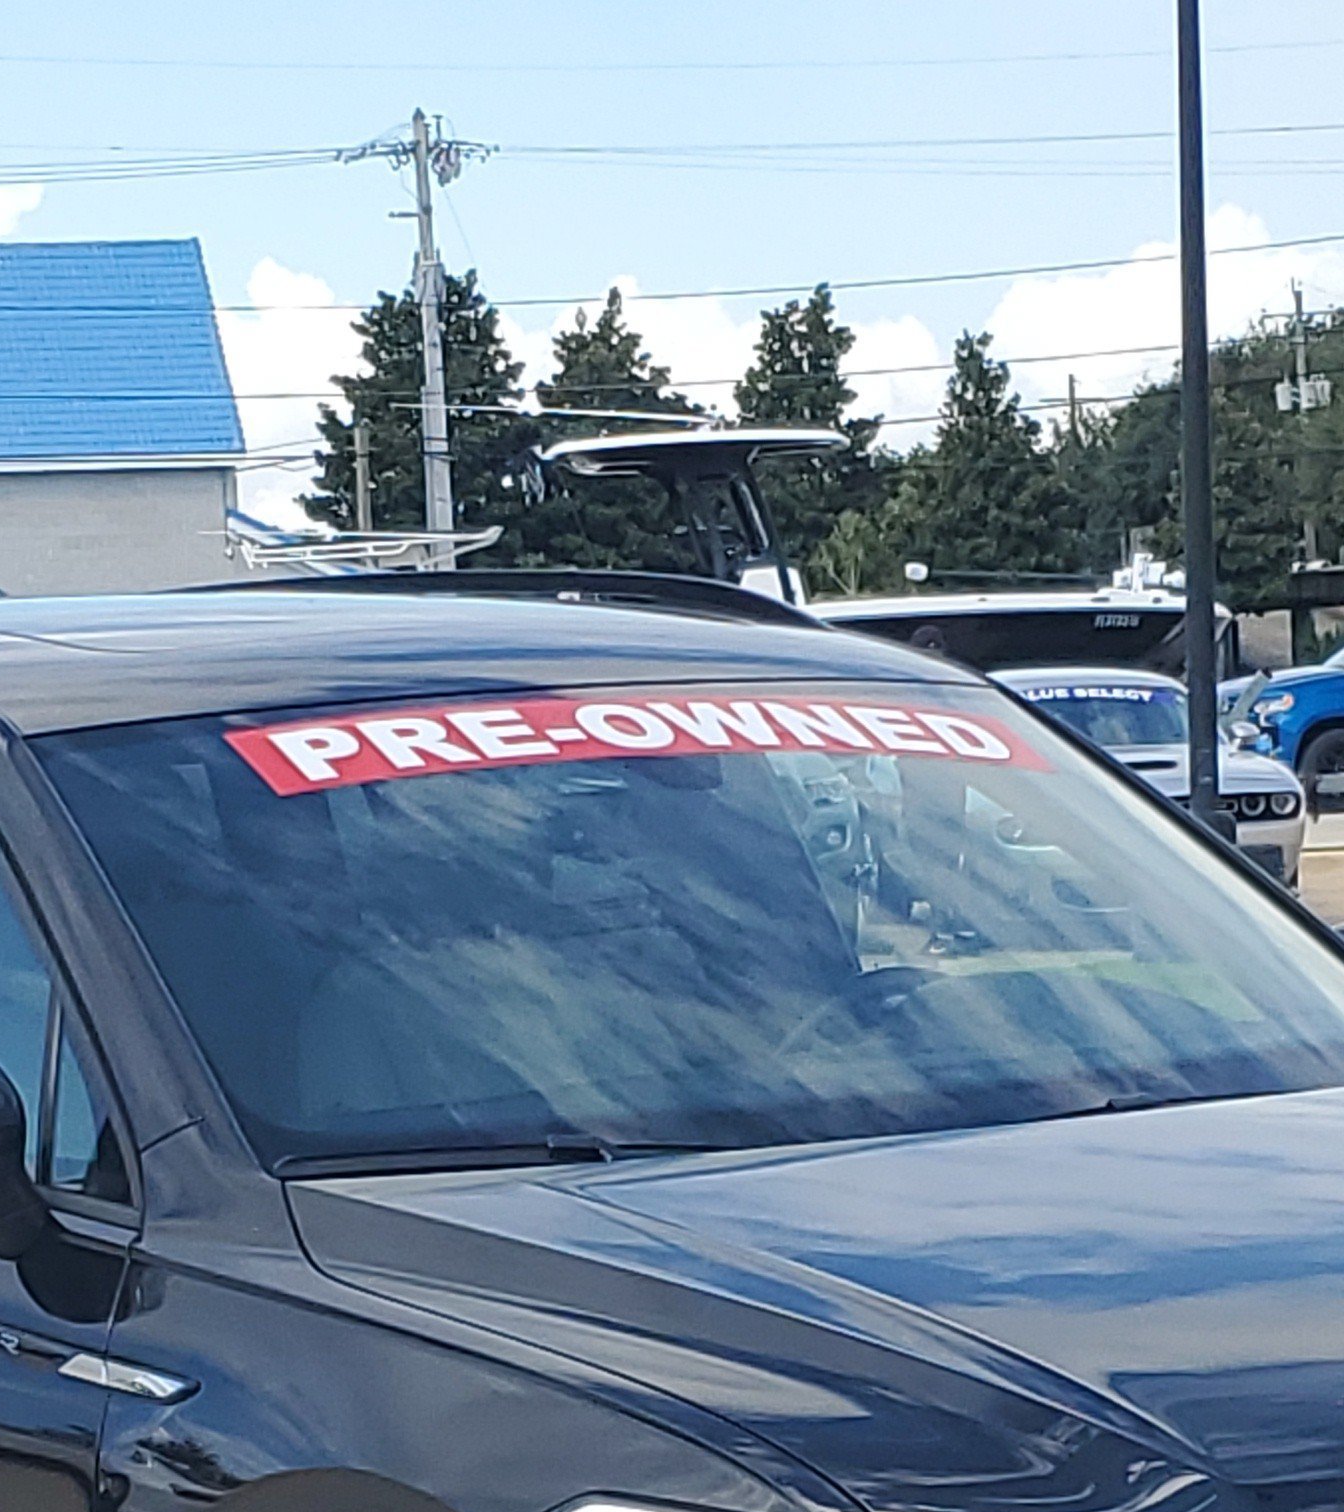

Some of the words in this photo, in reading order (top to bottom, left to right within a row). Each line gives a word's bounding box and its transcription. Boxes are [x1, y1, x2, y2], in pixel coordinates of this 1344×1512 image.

[1027, 688, 1070, 701] LUE
[1073, 687, 1153, 702] SELECT
[268, 701, 1013, 782] PRE-OWNED
